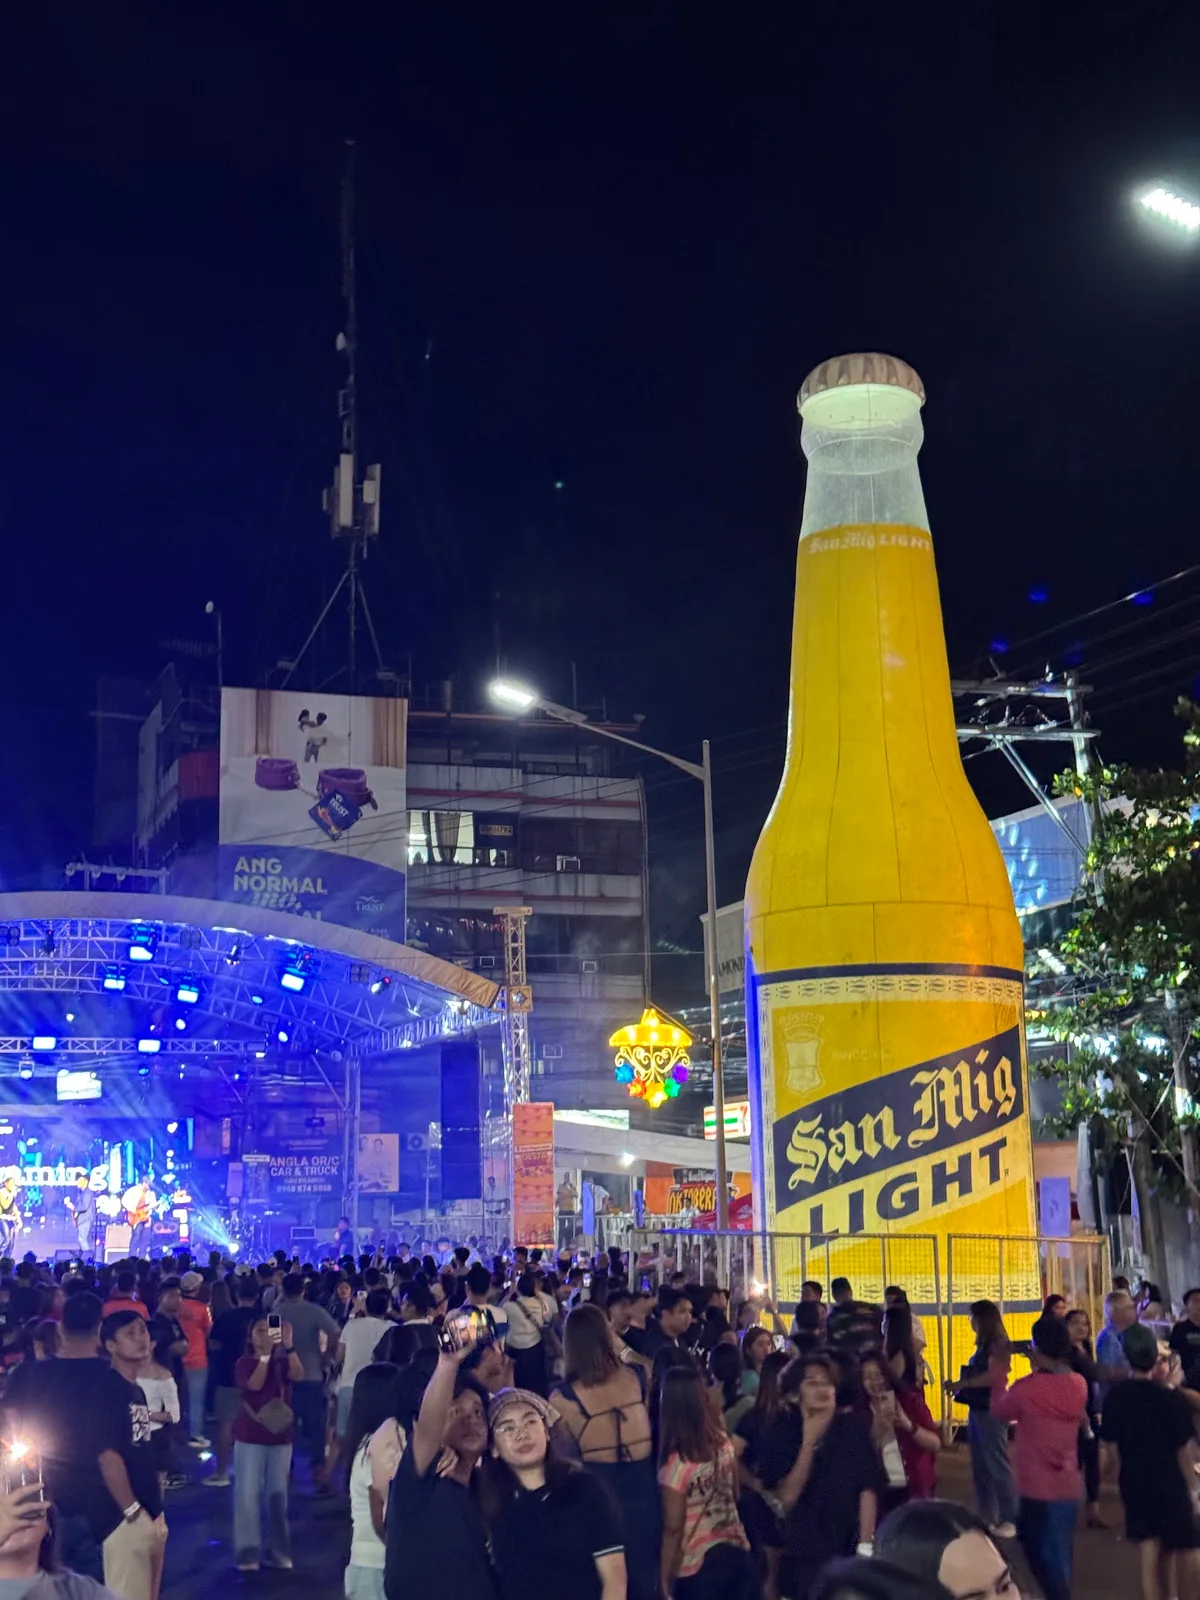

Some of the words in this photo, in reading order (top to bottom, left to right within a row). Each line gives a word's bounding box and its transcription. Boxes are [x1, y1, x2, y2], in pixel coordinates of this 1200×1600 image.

[328, 797, 349, 817] TRUST
[235, 856, 282, 873] ANG
[233, 875, 327, 894] NORMAL
[786, 1104, 902, 1190] San
[907, 1048, 1017, 1149] Mig
[271, 1167, 292, 1176] CAR
[304, 1166, 338, 1176] TRUCK
[809, 1136, 1008, 1250] LIGHT
